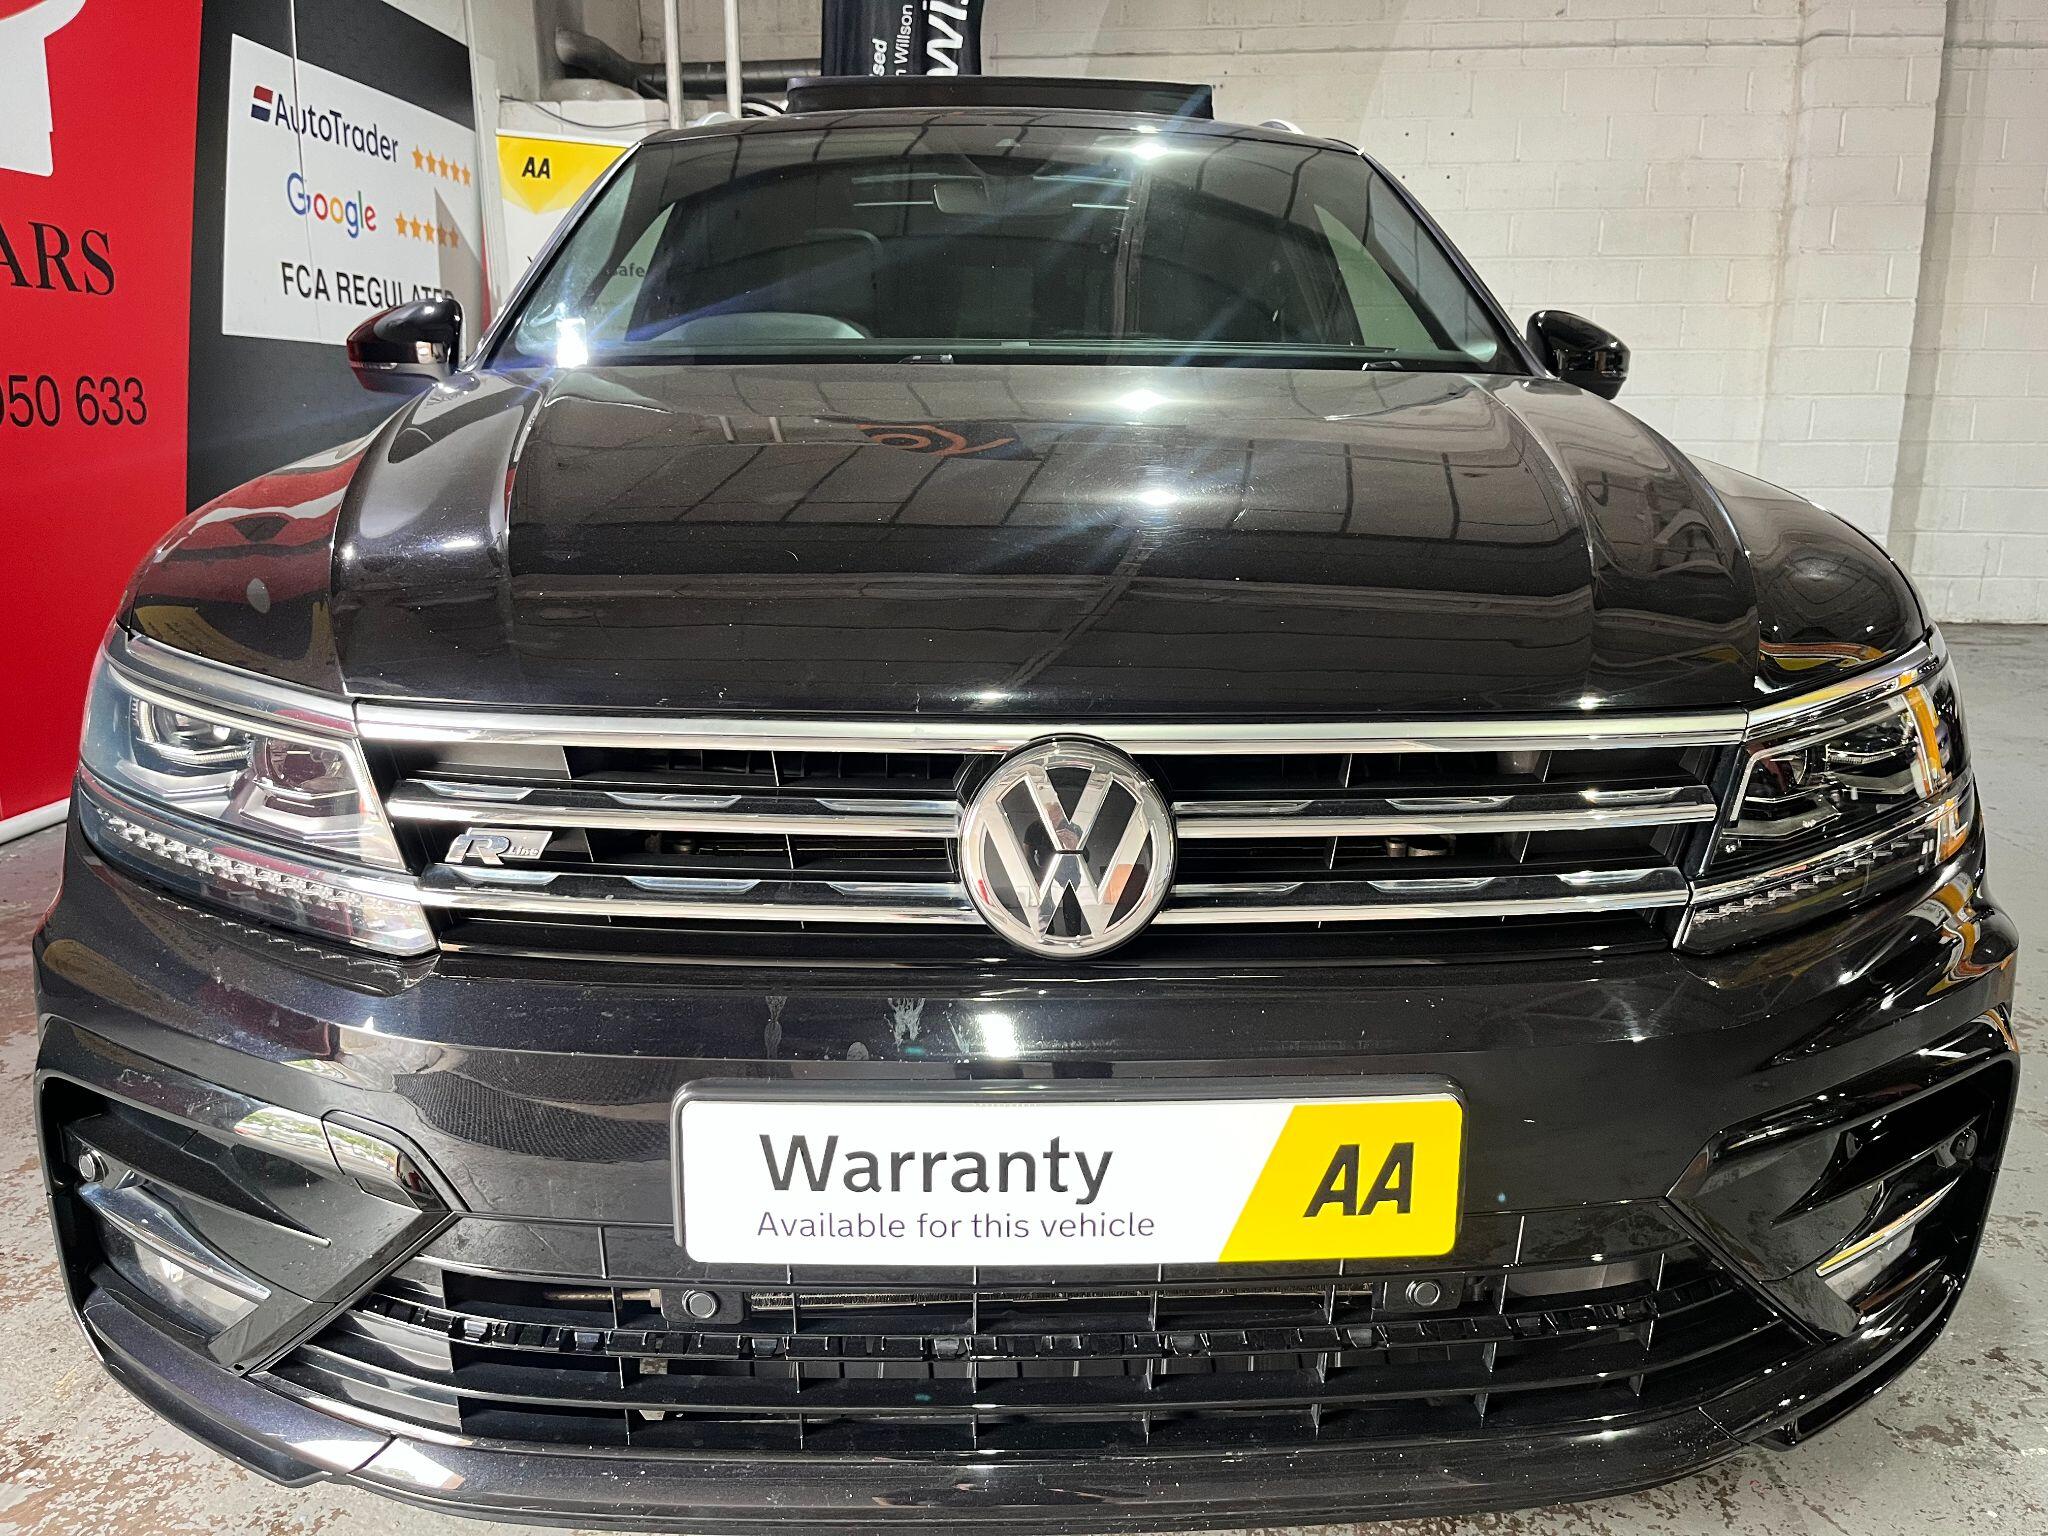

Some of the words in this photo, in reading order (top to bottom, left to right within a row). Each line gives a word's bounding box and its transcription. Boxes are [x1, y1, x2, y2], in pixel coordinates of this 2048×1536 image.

[870, 38, 888, 76] sed
[893, 4, 914, 64] Willson
[275, 94, 399, 162] AutoTrader
[521, 156, 551, 179] AA
[287, 172, 377, 239] Google
[281, 261, 330, 302] FCA
[616, 263, 645, 278] afe
[0, 374, 61, 428] 50
[75, 375, 148, 426] 633
[759, 1133, 1114, 1205] Warranty
[1302, 1141, 1416, 1218] AA
[757, 1211, 906, 1238] Available
[916, 1212, 962, 1238] for
[971, 1212, 1030, 1238] this
[1041, 1211, 1156, 1238] vehicle
